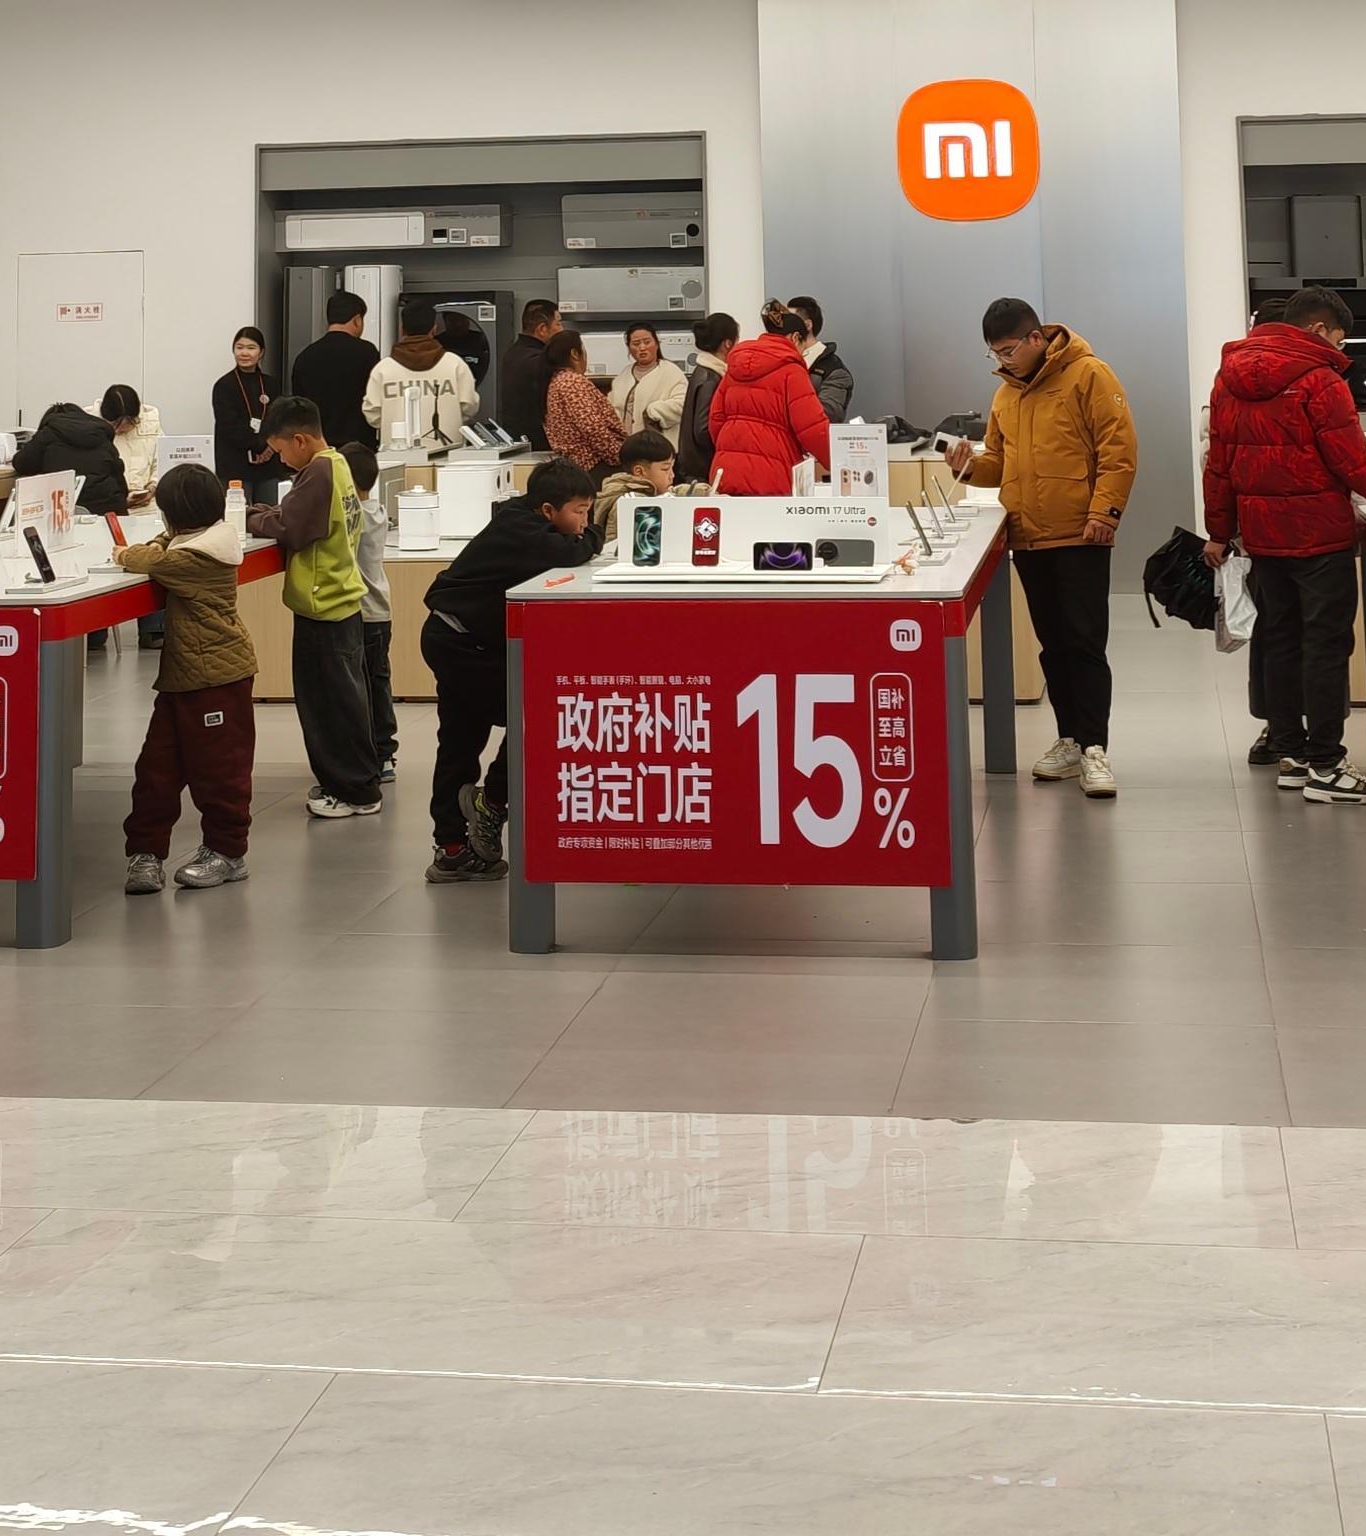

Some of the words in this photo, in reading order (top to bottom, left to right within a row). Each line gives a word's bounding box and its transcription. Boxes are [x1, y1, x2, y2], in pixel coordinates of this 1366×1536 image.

[383, 379, 456, 399] CHNA
[786, 506, 830, 515] xiaomi
[833, 506, 842, 515] 17
[844, 506, 866, 515] Ultra
[877, 688, 905, 710] 国补
[556, 692, 711, 754] 政府补贴
[878, 716, 906, 739] 至高
[736, 673, 863, 849] 15
[879, 745, 907, 767] 立省
[557, 761, 712, 824] 指定门店
